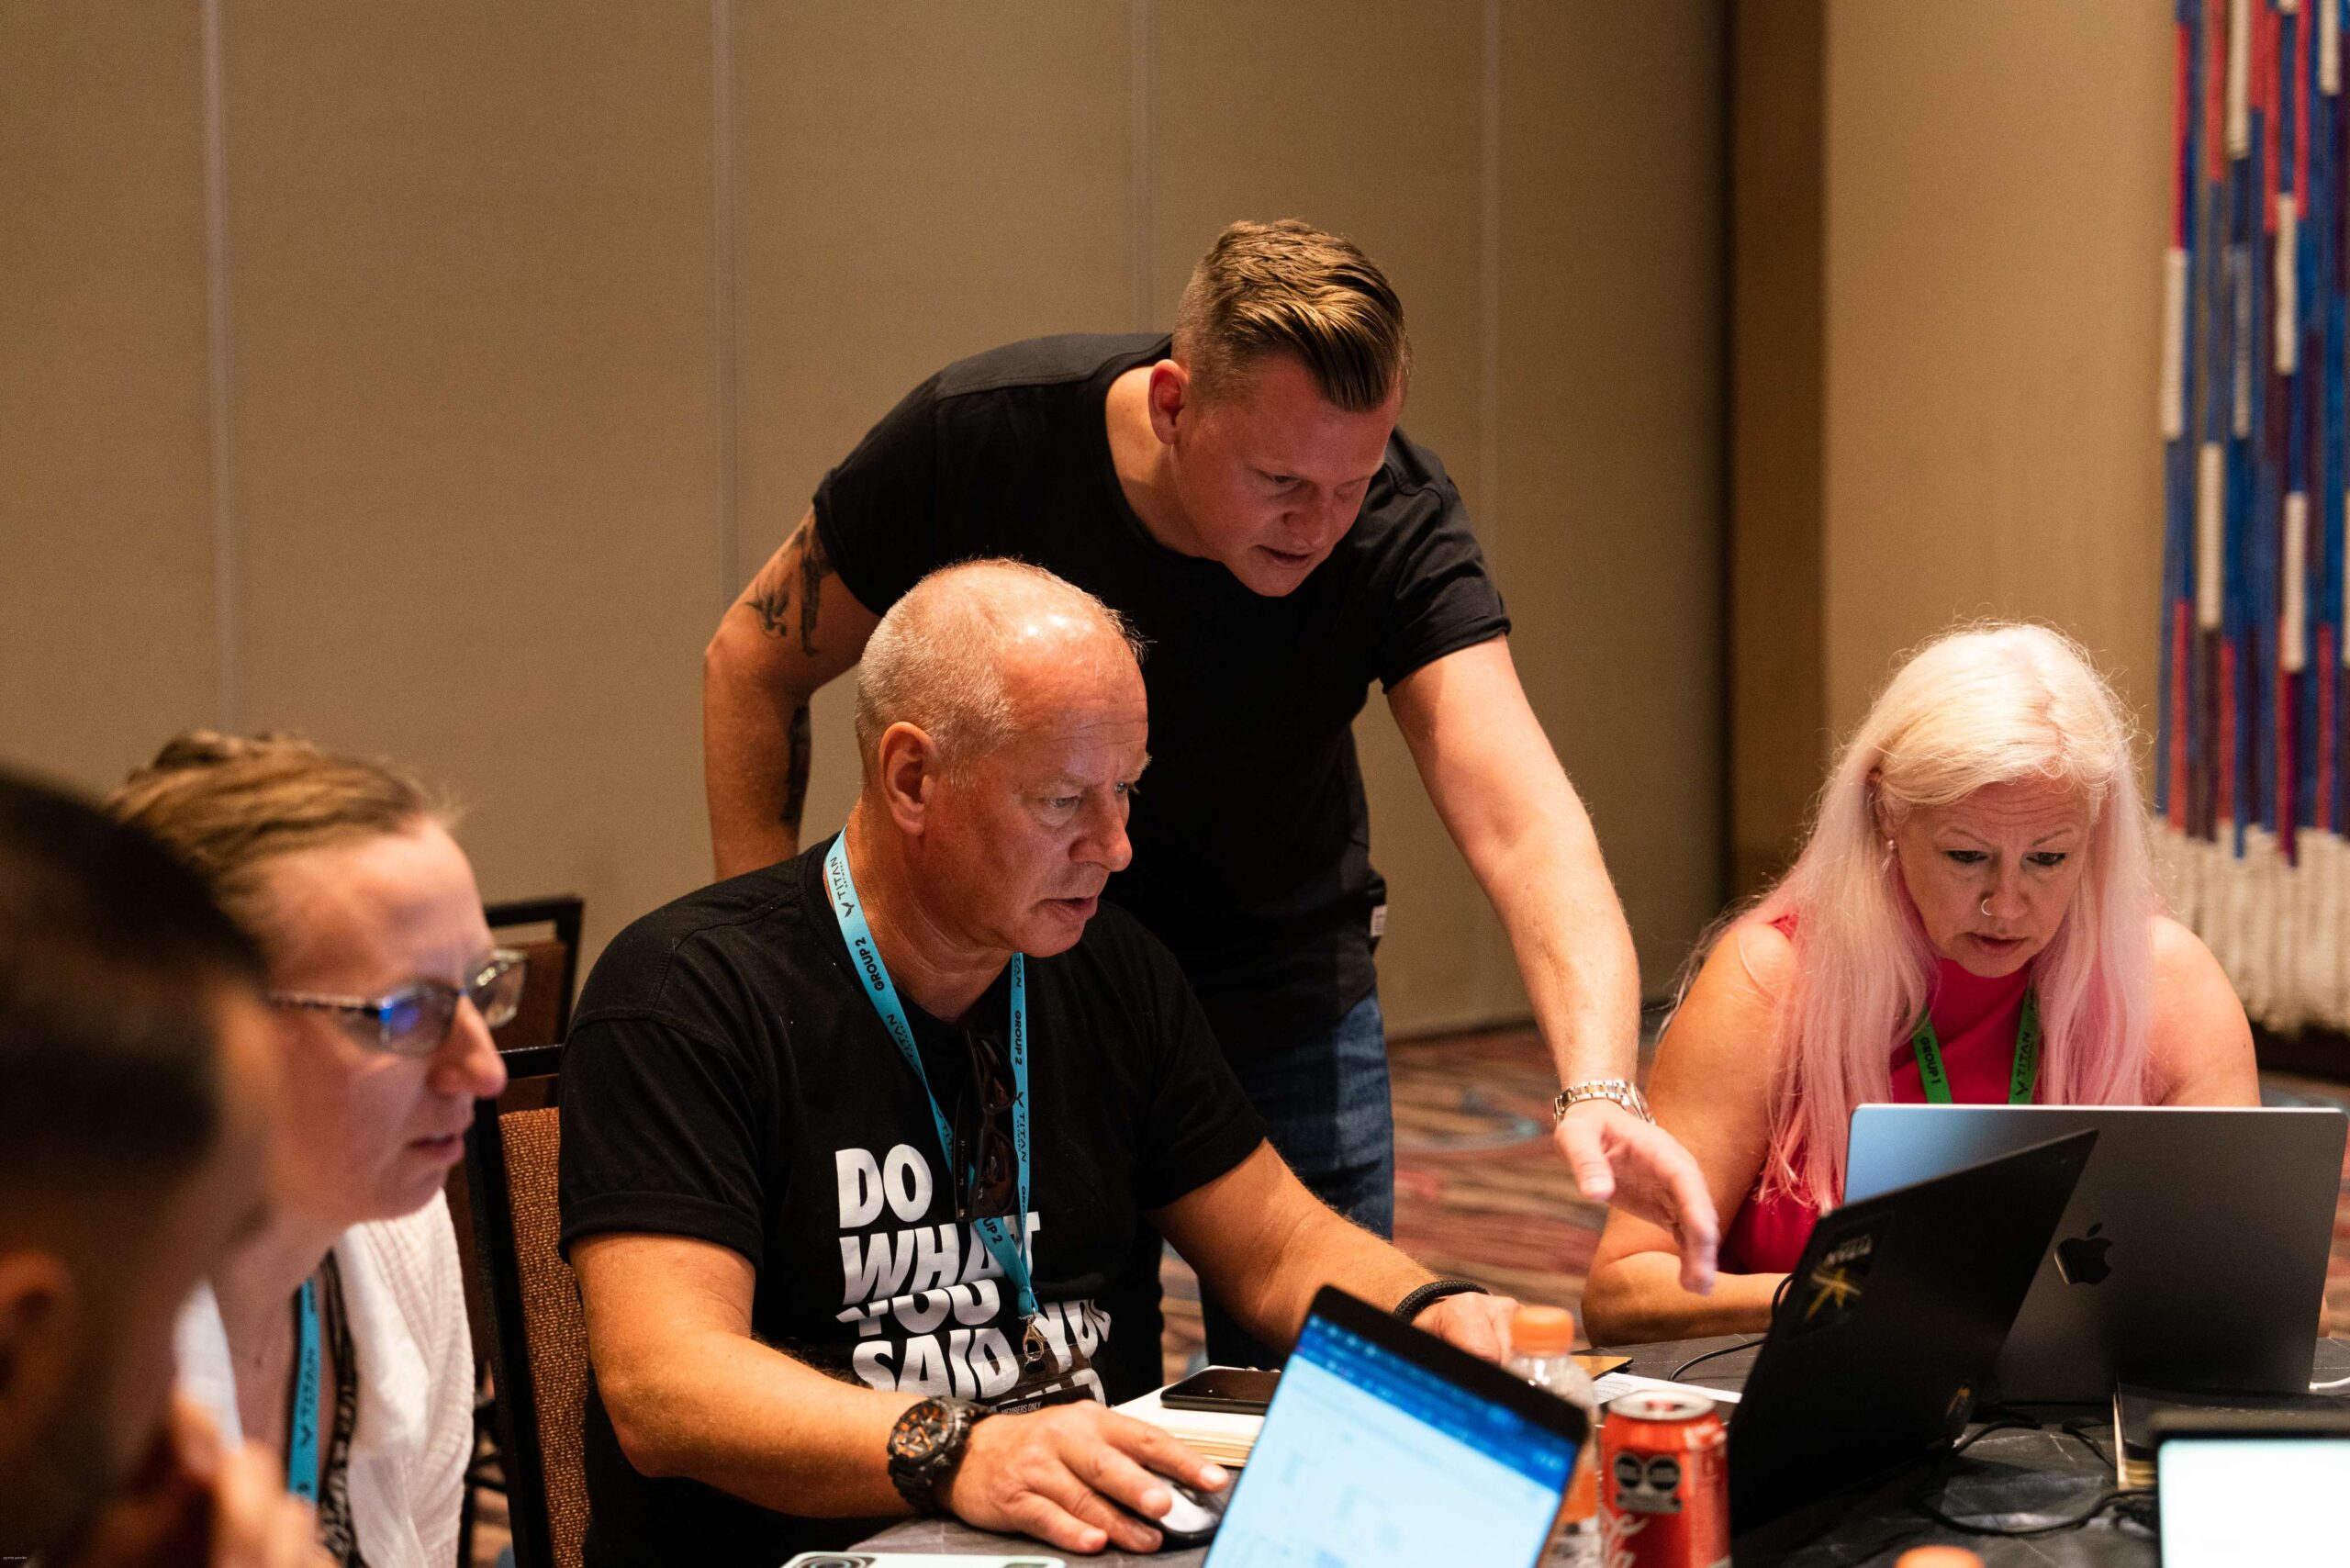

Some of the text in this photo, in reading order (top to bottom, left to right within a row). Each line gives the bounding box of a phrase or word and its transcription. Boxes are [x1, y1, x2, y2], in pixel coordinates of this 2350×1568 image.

[830, 857, 845, 901] TITAN
[855, 936, 885, 991] GROUP 2
[887, 1014, 914, 1062] TITAN
[1014, 1010, 1023, 1066] GROUP 2
[1920, 1037, 1939, 1077] GROUP
[2017, 1032, 2031, 1077] TITAN
[1019, 1113, 1027, 1162] TITAN
[834, 1143, 933, 1228] DO
[838, 1211, 1041, 1305] WHAT
[852, 1327, 1020, 1399] SAID
[1027, 1401, 1042, 1412] ONLY
